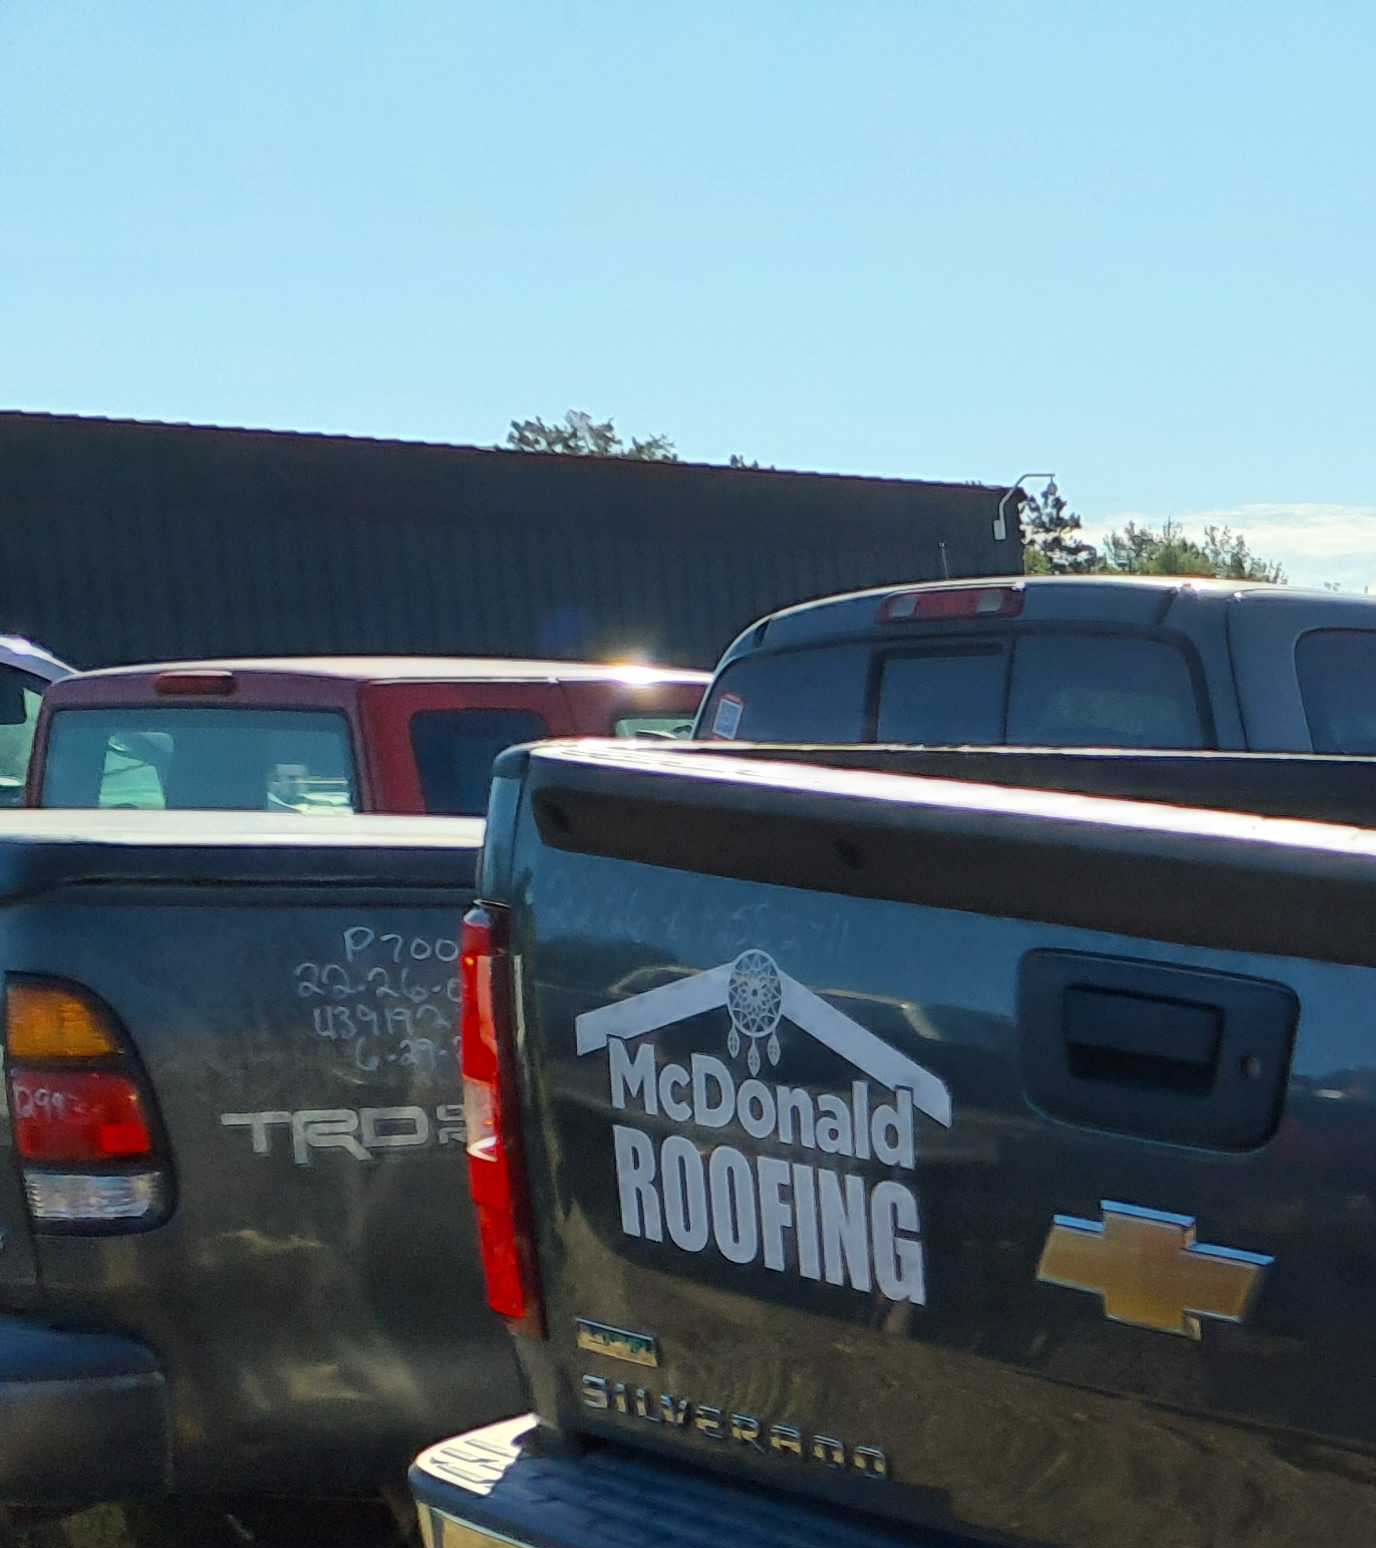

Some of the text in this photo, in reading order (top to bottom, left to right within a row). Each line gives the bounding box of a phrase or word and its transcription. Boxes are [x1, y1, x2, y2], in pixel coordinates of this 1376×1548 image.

[220, 1105, 430, 1165] TRD
[607, 1036, 916, 1170] McDonald
[612, 1124, 928, 1307] ROOFING
[581, 1373, 888, 1480] SILVERADO
